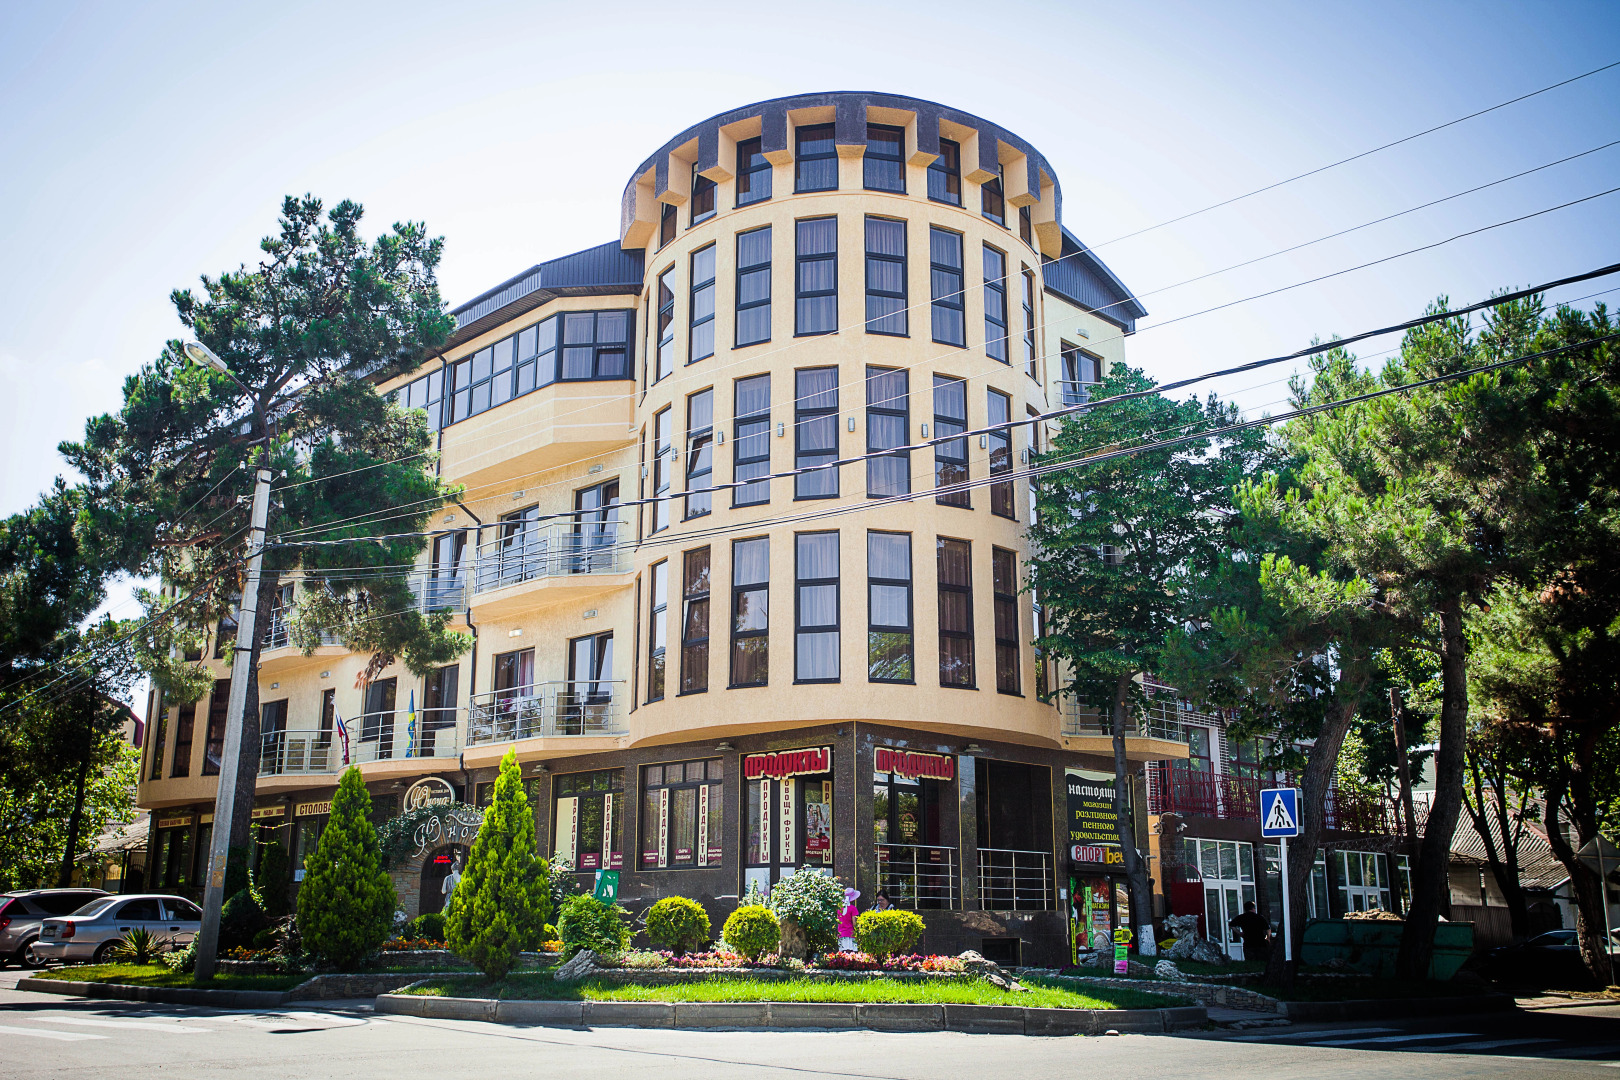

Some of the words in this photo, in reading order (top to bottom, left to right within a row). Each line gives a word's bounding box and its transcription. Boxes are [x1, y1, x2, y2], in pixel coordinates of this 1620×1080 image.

[744, 748, 829, 779] ПРОДУКТЫ
[876, 749, 954, 779] ПРОДУКТЫ
[783, 780, 791, 815] ОВОЩИ
[1082, 801, 1112, 809] магазин
[603, 795, 611, 867] ПРОДУКТЫ
[699, 786, 707, 863] ПРОДУКТЫ
[761, 781, 769, 861] ПРОДУКТЫ
[1082, 821, 1115, 830] пенного
[783, 819, 792, 862] ФРУКТЫ
